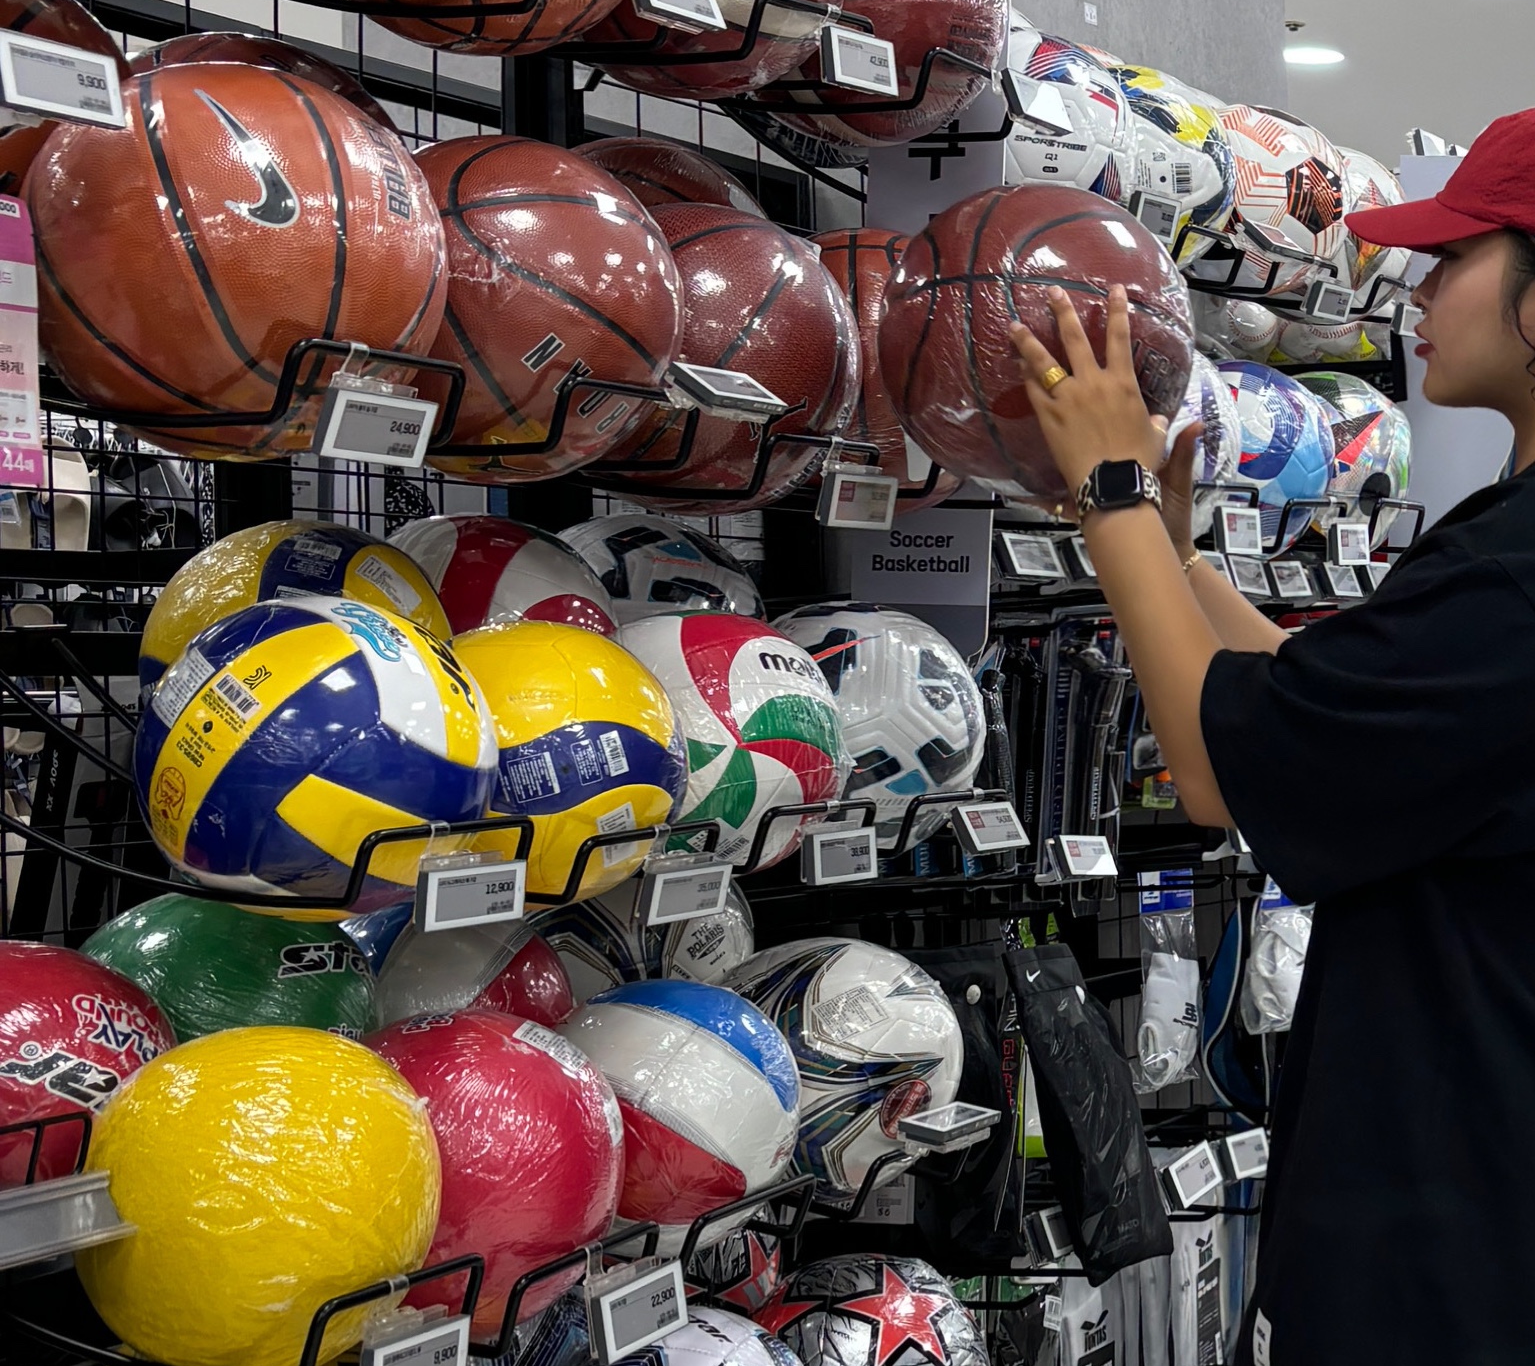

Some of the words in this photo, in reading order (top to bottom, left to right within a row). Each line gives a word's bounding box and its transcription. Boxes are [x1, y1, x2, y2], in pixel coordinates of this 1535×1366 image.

[76, 72, 107, 91] 9,900
[389, 420, 421, 437] 24,900
[889, 530, 955, 549] Soccer
[871, 553, 971, 574] Basketball
[485, 880, 515, 895] 12,900
[686, 924, 725, 962] POLARIS
[651, 1286, 676, 1308] 22,900
[433, 1344, 458, 1365] 9,900
